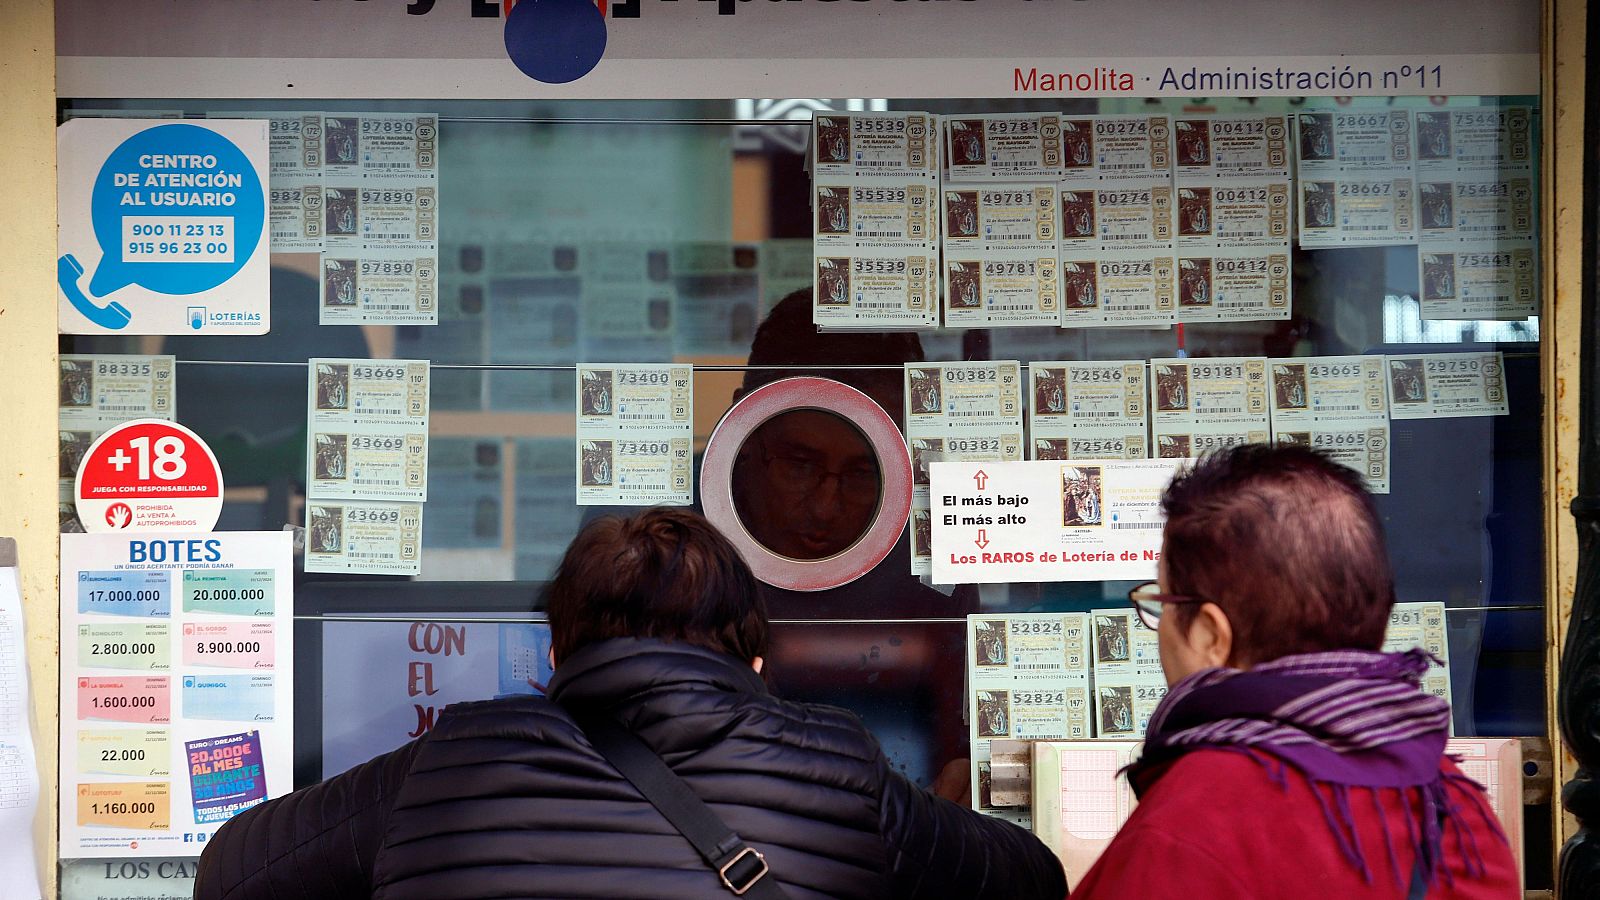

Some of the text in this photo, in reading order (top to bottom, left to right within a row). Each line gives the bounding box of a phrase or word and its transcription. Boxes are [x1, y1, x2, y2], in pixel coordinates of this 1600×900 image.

[1014, 65, 1442, 91] Manolita Administración nº11
[855, 120, 905, 131] 35539
[1337, 116, 1387, 128] 28667
[1455, 114, 1505, 125] 75441
[362, 122, 413, 132] 97890
[988, 121, 1038, 133] 49781
[1096, 122, 1147, 134] 00274
[1213, 123, 1263, 134] 00412
[139, 154, 217, 169] CENTRO
[114, 170, 242, 188] DE ATENCIÓN
[1340, 183, 1391, 195] 28667
[1458, 184, 1508, 196] 75441
[119, 191, 236, 206] AL USUARIO
[362, 192, 413, 202] 97890
[855, 190, 905, 201] 35539
[983, 193, 1033, 204] 49781
[1099, 193, 1150, 204] 00274
[1216, 190, 1267, 201] 00412
[132, 225, 225, 237] 900 11 23 13
[129, 242, 228, 254] 915 96 23 00
[362, 263, 413, 273] 97890
[855, 261, 906, 272] 35539
[985, 263, 1035, 274] 49781
[1101, 263, 1152, 275] 00274
[1216, 260, 1267, 272] 00412
[210, 311, 261, 321] LOTERÍAS
[99, 364, 150, 375] 88335
[1193, 366, 1242, 377] 99181
[1310, 365, 1361, 377] 43665
[1428, 361, 1478, 371] 29750
[353, 368, 405, 379] 43669
[618, 373, 669, 384] 73400
[946, 370, 997, 382] 00382
[1071, 370, 1122, 381] 72546
[352, 438, 403, 449] 43669
[1195, 437, 1245, 448] 99181
[1315, 433, 1365, 445] 43665
[618, 443, 669, 454] 73400
[949, 440, 1000, 451] 00382
[1072, 441, 1123, 452] 72546
[107, 435, 187, 481] +18
[943, 494, 1029, 508] El más bajo
[348, 510, 399, 522] 43669
[943, 513, 1027, 526] El más alto
[129, 539, 221, 563] BOTES
[950, 553, 977, 564] Los
[982, 552, 1034, 564] RAROS
[1039, 552, 1057, 563] de
[1062, 550, 1115, 563] Lotería
[1120, 550, 1138, 562] de
[89, 590, 160, 602] 17.000.000
[193, 589, 265, 601] 20.000.000
[1011, 623, 1062, 633] 52824
[407, 622, 466, 656] CON
[92, 643, 156, 655] 2.800.000
[197, 641, 260, 653] 8.900.000
[408, 662, 439, 697] EL
[92, 697, 156, 708] 1.600.000
[1013, 694, 1064, 704] 52824
[189, 736, 244, 750] EURO DREAMS
[101, 749, 145, 761] 22.000
[190, 743, 252, 764] 20.000€
[192, 756, 244, 776] AL MES
[193, 763, 261, 787] DURANTE
[92, 803, 155, 815] 1.160.000
[197, 806, 223, 816] TODOS
[223, 803, 239, 812] LOS
[204, 811, 235, 821] JUEVES
[104, 862, 151, 879] LOS
